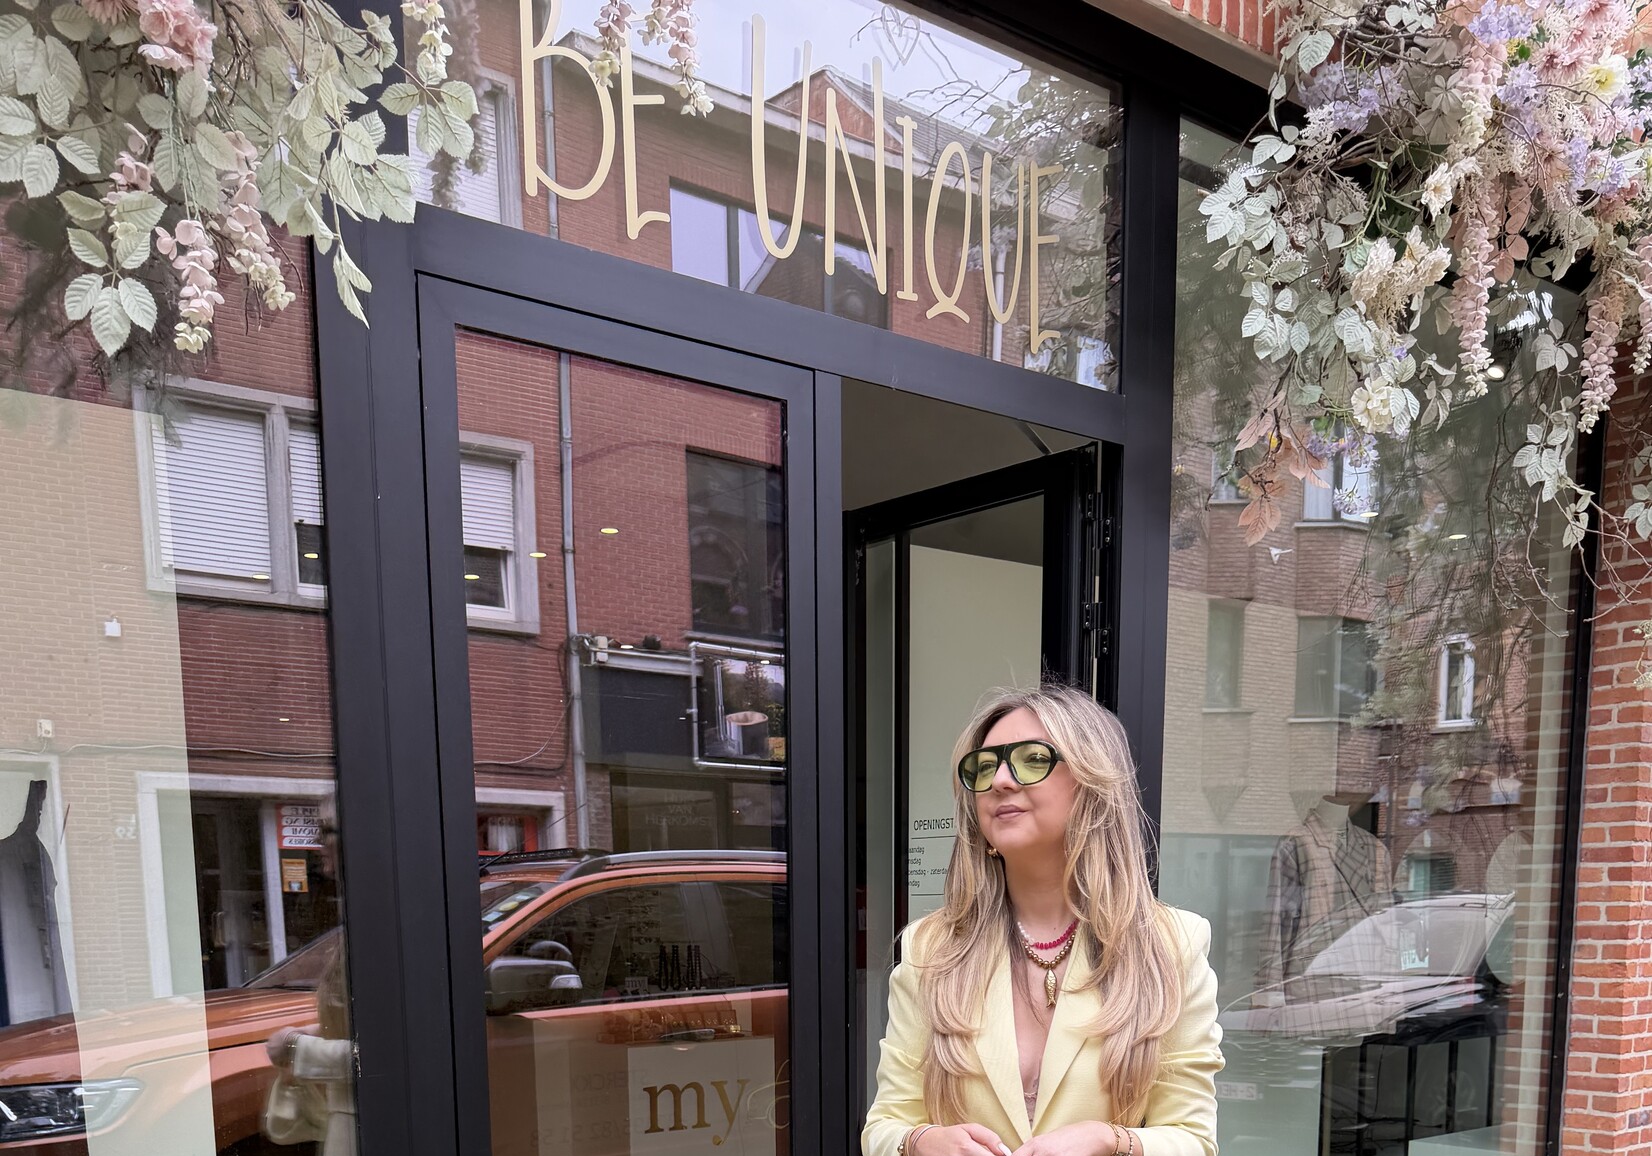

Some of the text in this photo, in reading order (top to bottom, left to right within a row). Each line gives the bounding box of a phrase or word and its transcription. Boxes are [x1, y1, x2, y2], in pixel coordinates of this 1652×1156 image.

[520, 0, 1062, 355] BE UNIQUE
[643, 1079, 750, 1146] my
